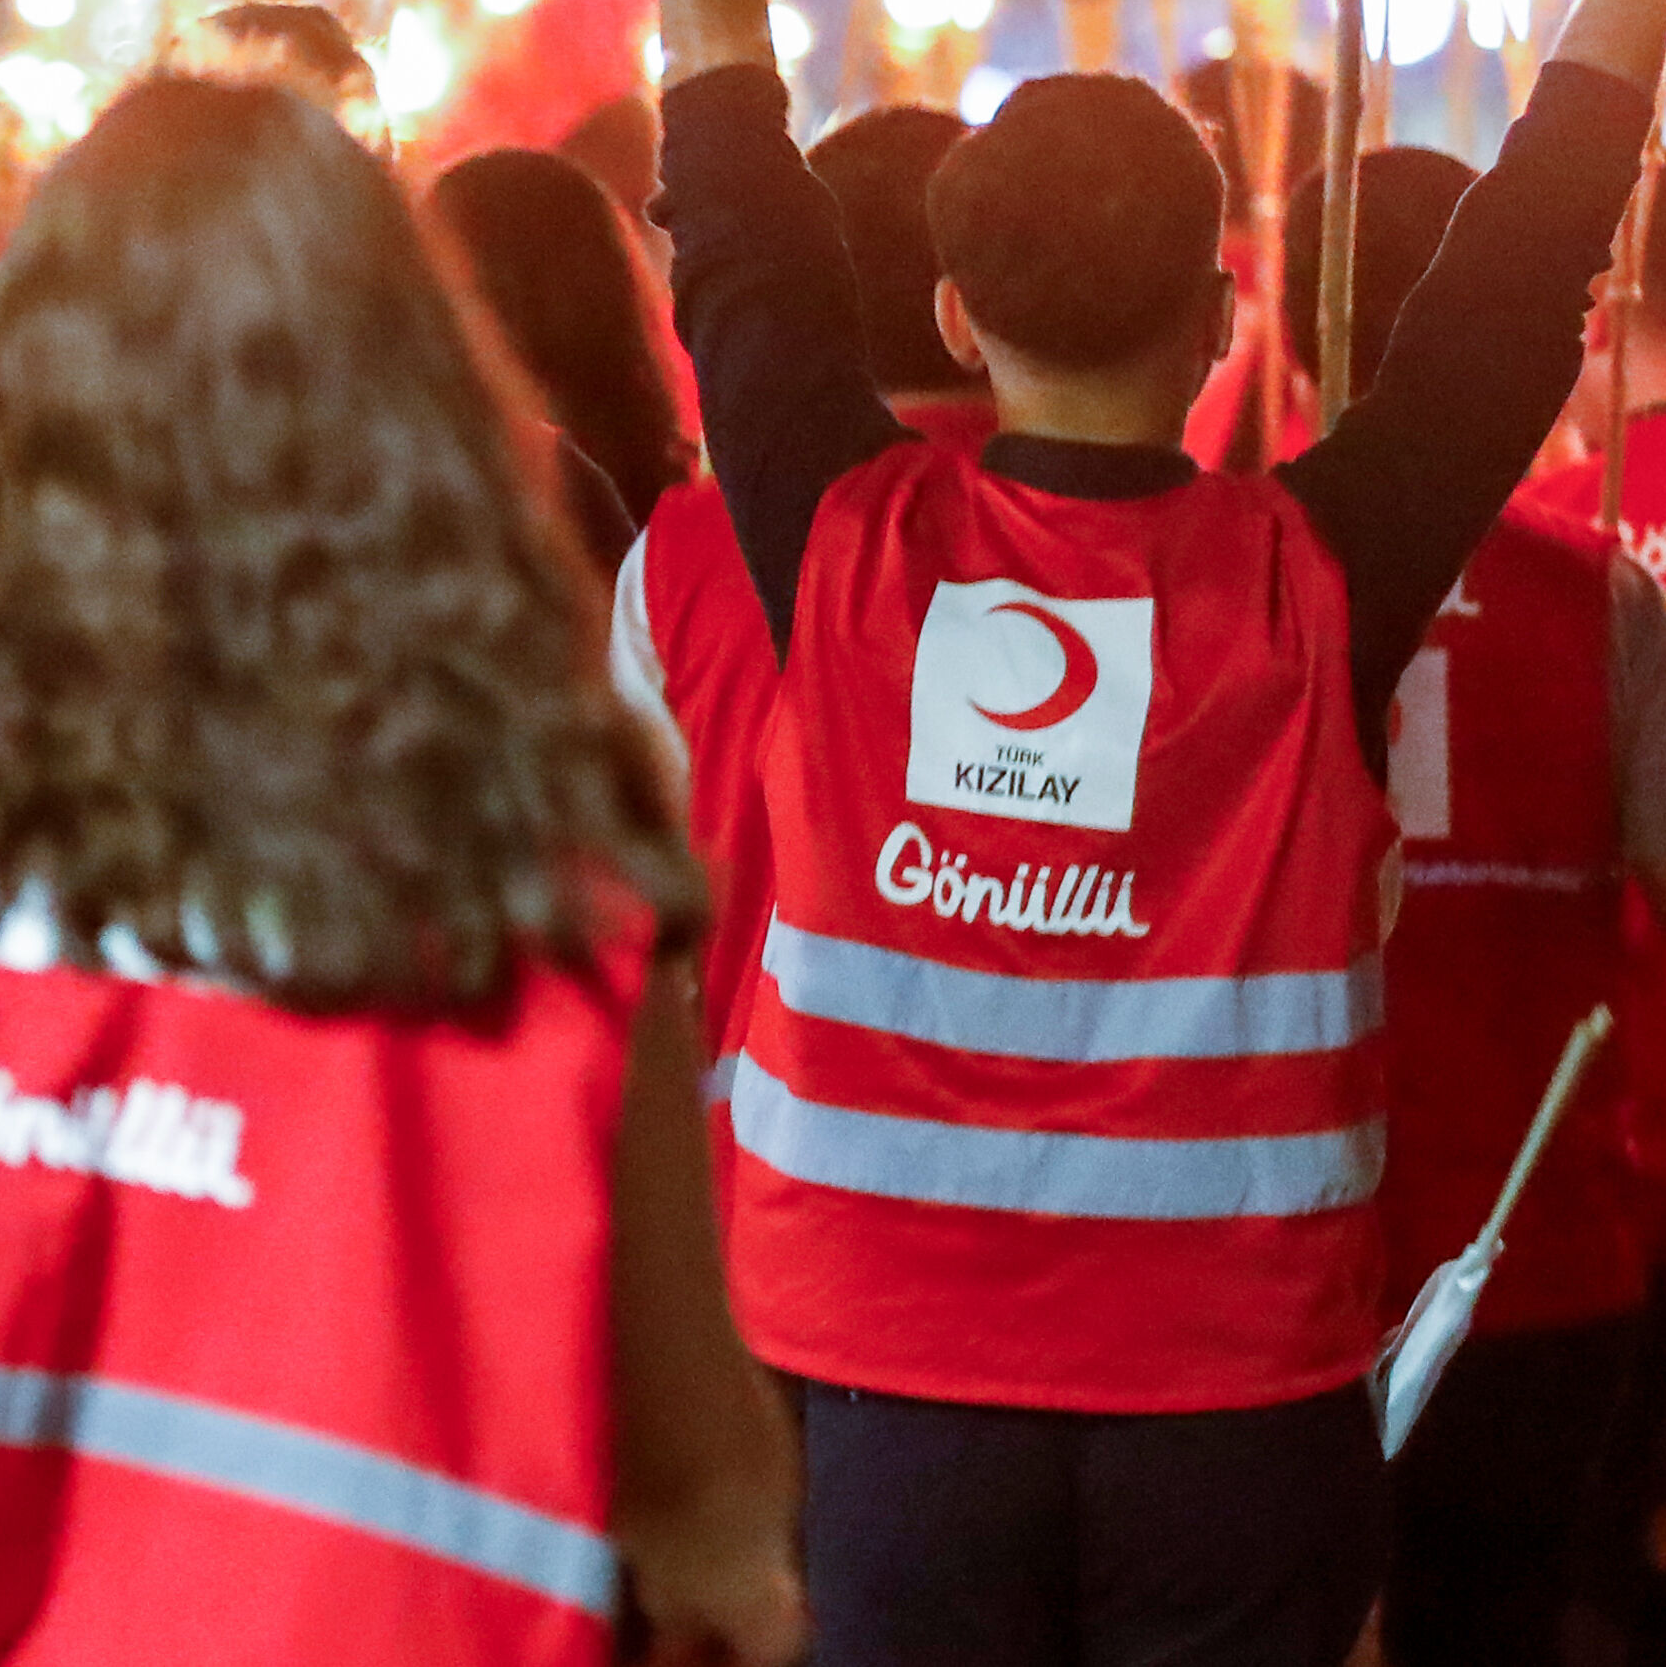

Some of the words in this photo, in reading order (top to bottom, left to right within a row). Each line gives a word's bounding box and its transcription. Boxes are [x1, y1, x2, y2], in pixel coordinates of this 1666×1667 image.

[995, 743, 1045, 766] TÜRK
[954, 762, 1081, 805] KIZILAY
[875, 821, 1149, 937] Gönüllü
